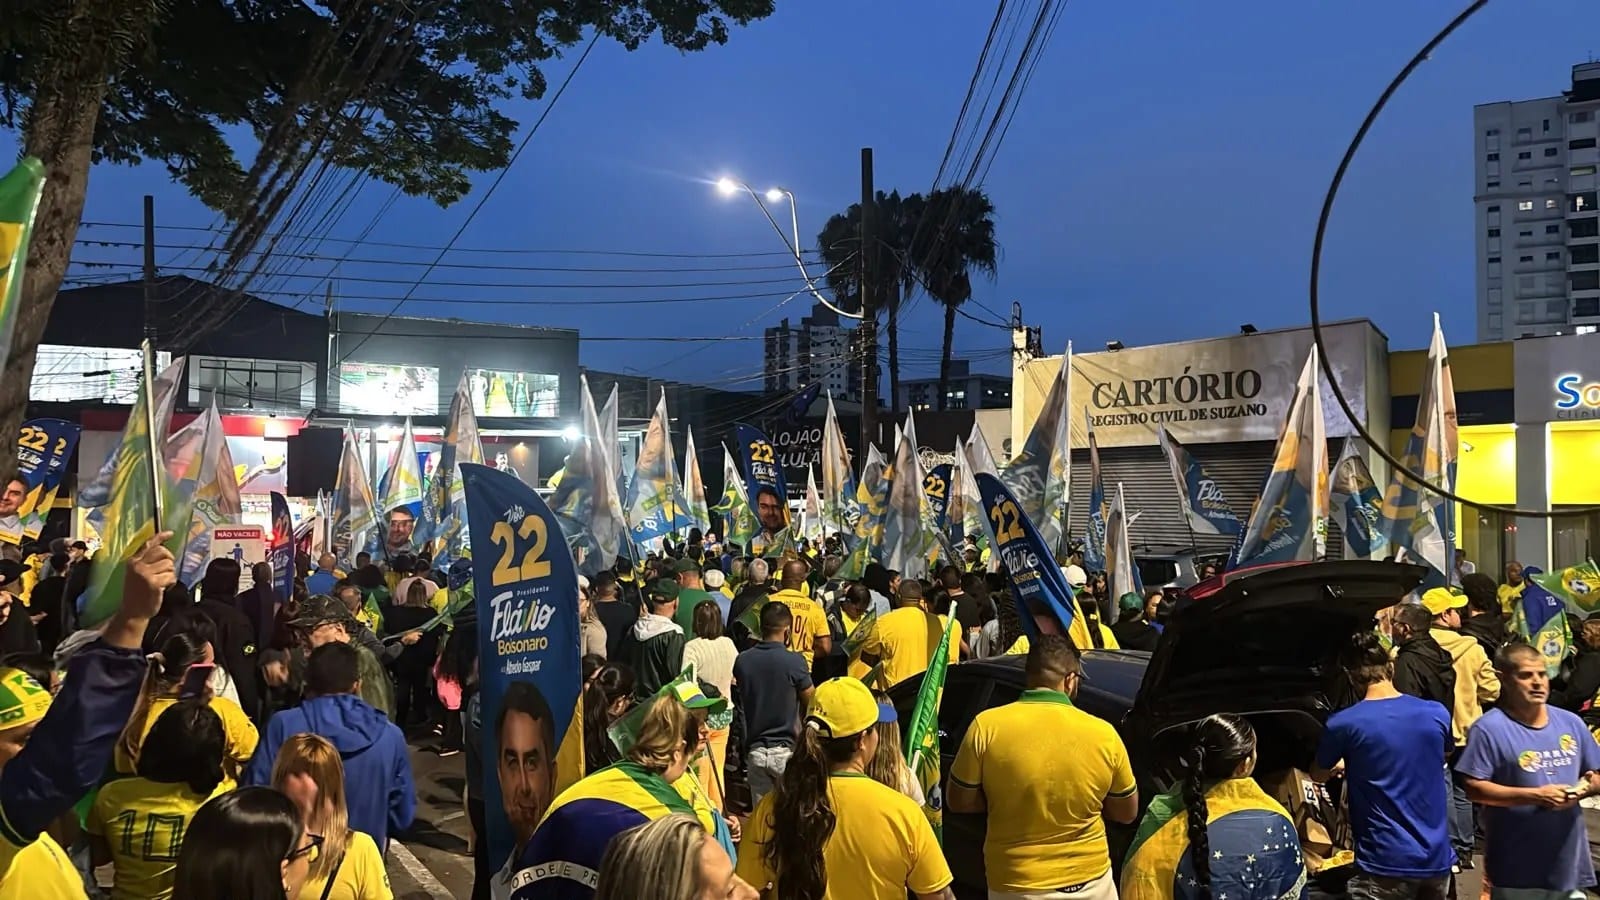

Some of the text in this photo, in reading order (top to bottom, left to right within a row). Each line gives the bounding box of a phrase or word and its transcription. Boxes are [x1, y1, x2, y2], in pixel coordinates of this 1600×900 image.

[1092, 366, 1262, 409] CARTÓRIO
[1090, 403, 1268, 427] REGISTRO CIVIL DE SUZANO
[18, 427, 49, 453] 22
[750, 442, 775, 464] 22
[926, 476, 945, 498] 22
[217, 530, 232, 538] NÃO
[991, 501, 1025, 545] 22
[490, 514, 551, 587] 22
[516, 585, 550, 597] Presidente
[490, 590, 556, 642] Flávio
[116, 808, 185, 862] 10
[511, 863, 562, 889] ORDE
